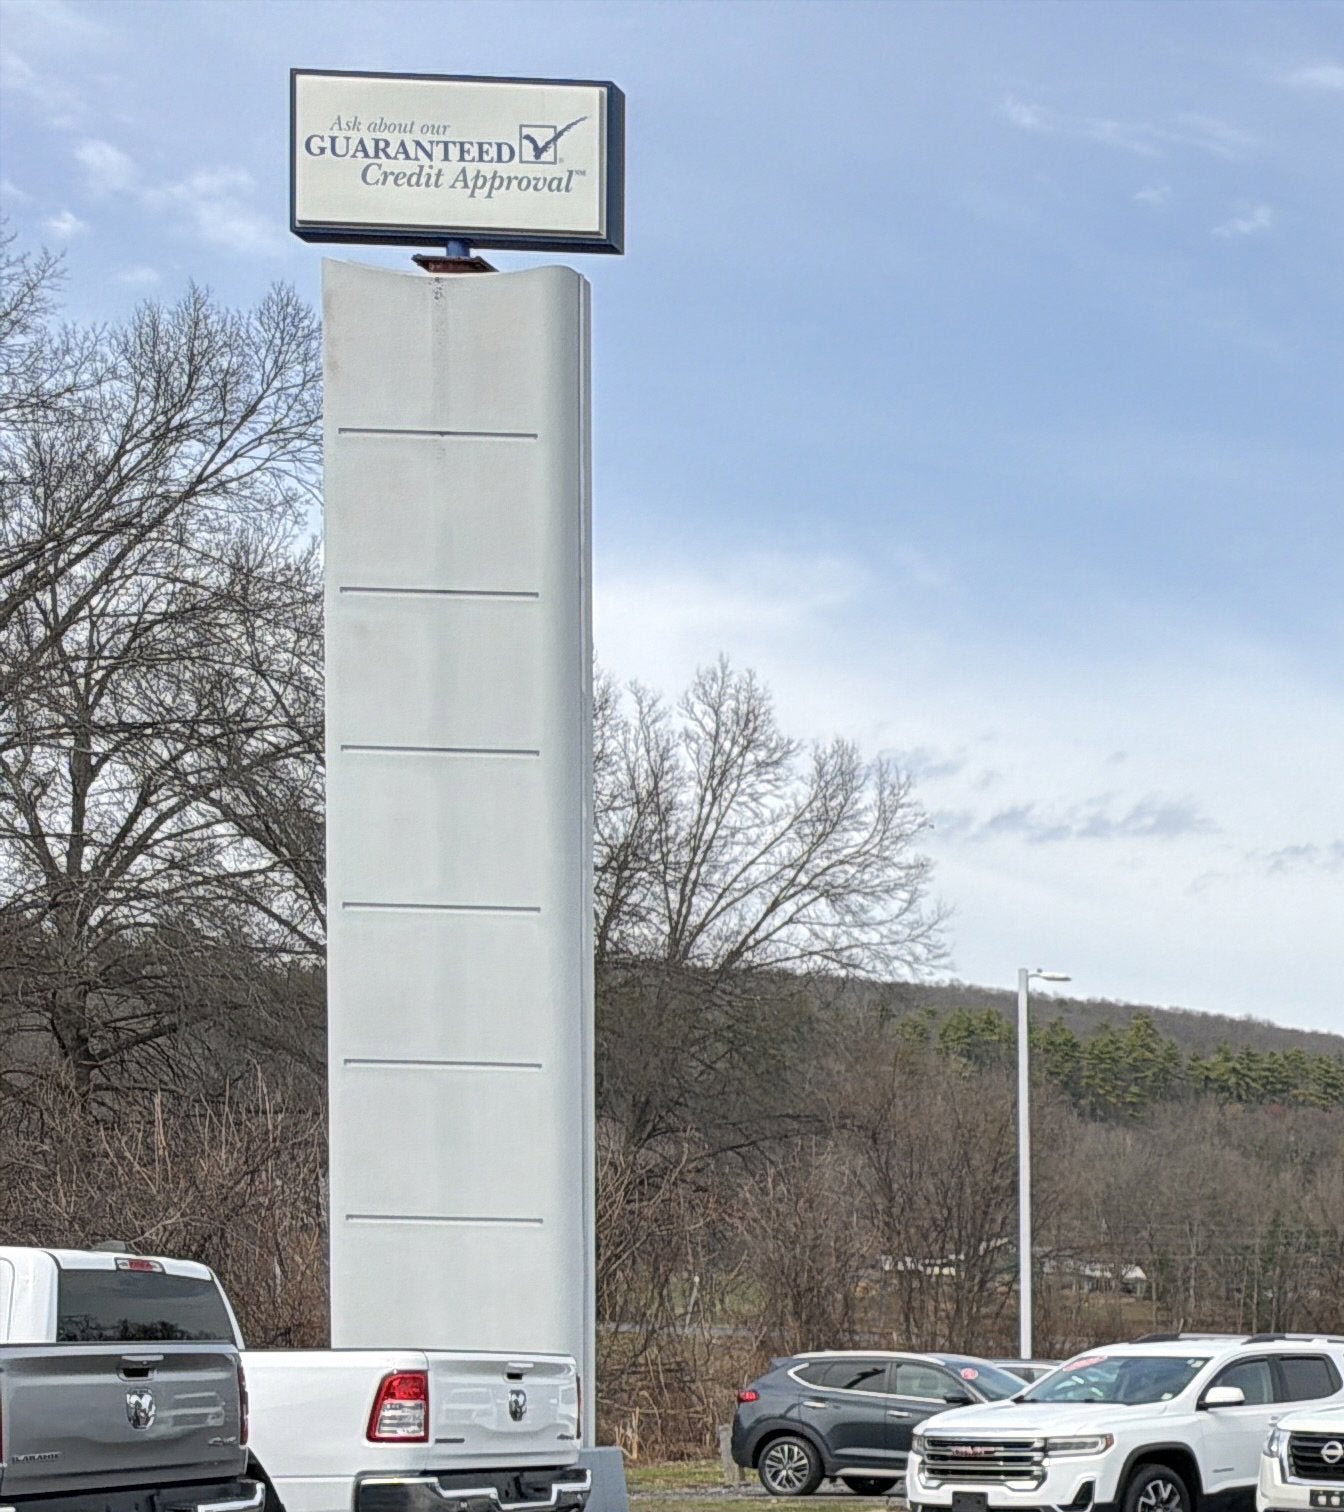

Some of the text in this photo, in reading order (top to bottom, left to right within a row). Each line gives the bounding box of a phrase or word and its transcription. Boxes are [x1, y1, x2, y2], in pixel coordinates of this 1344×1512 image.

[329, 114, 451, 136] Ask about our
[304, 134, 516, 164] GUARANTEED
[361, 163, 574, 199] Credit Approval
